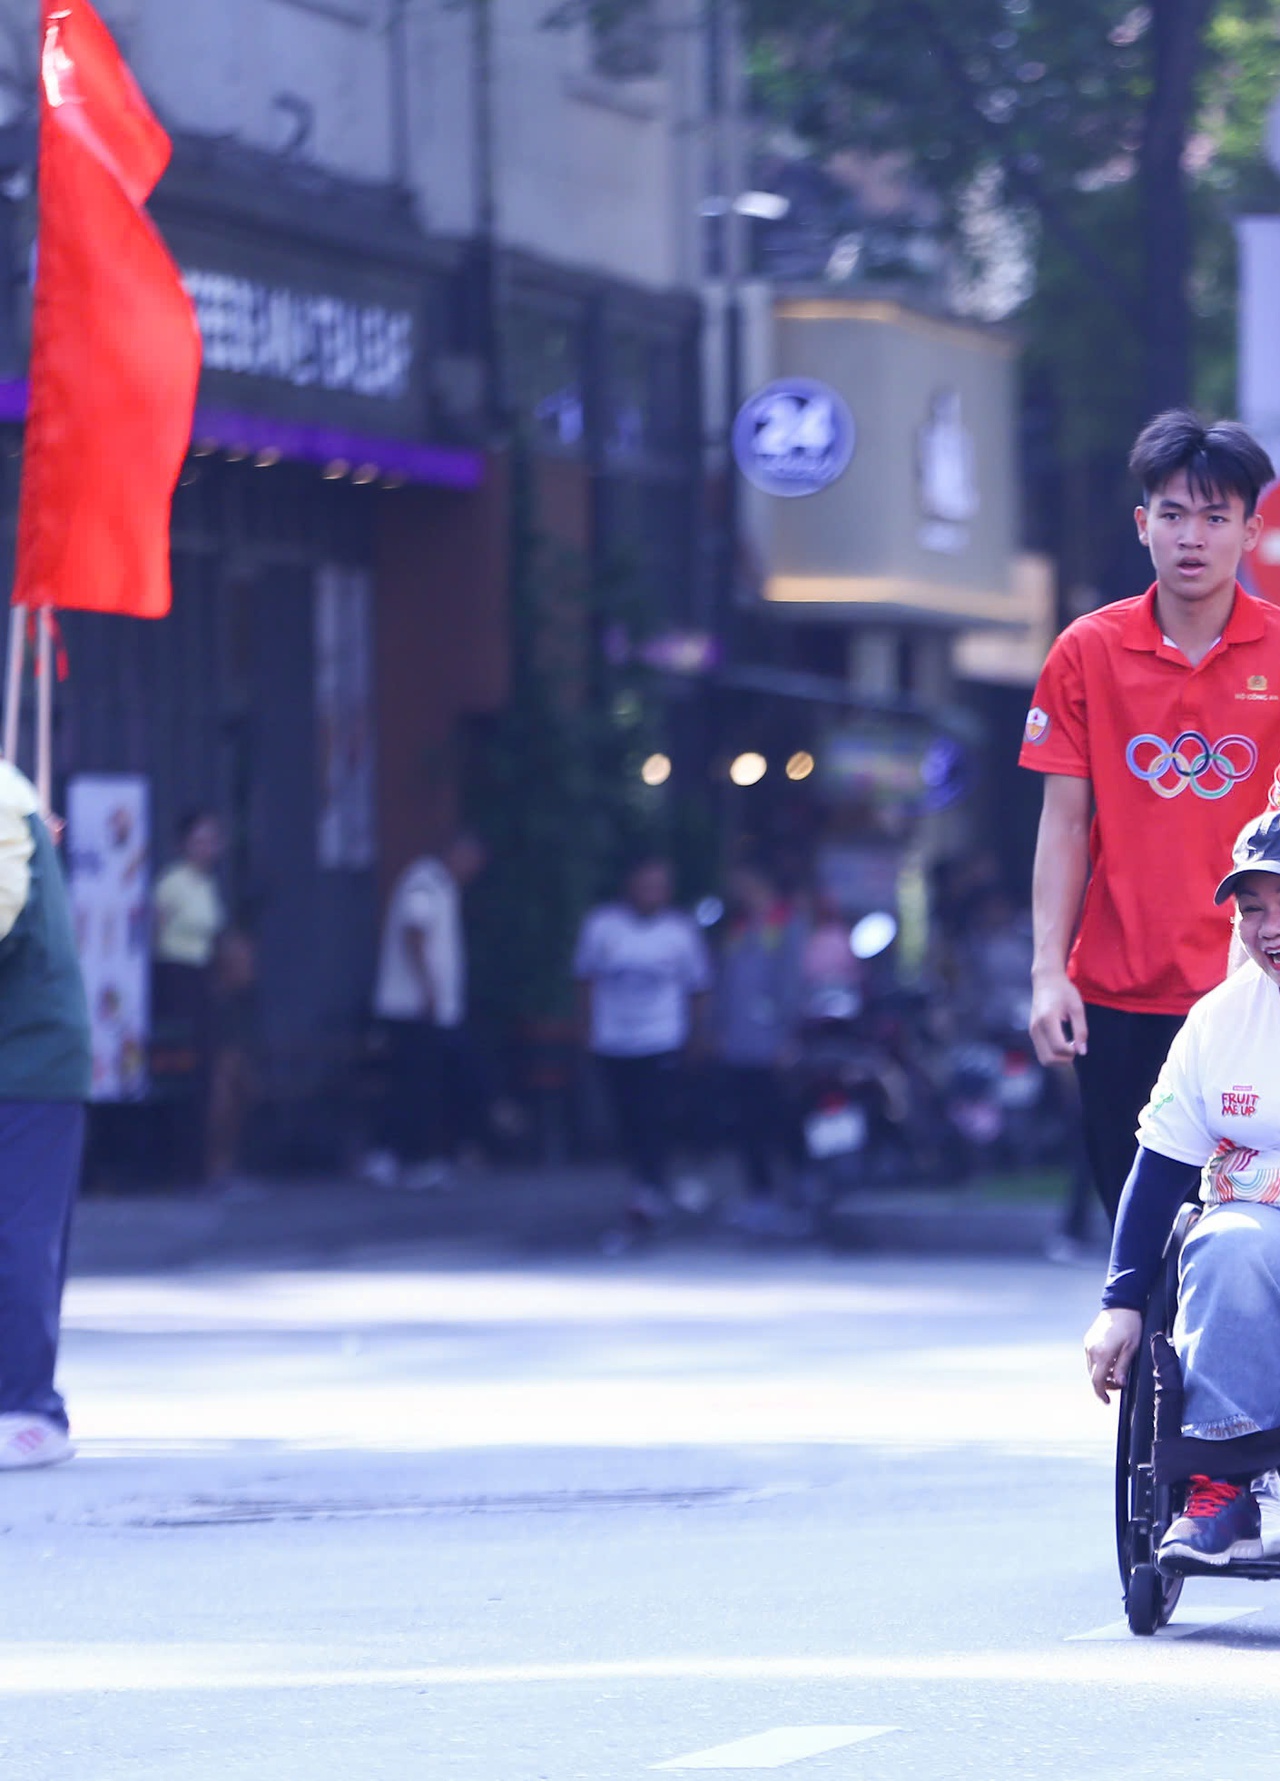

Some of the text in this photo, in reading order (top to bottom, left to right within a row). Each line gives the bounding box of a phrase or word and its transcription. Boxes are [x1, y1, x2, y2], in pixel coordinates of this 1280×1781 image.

[1221, 1092, 1260, 1106] FRUIT
[1221, 1104, 1256, 1117] ME UP
